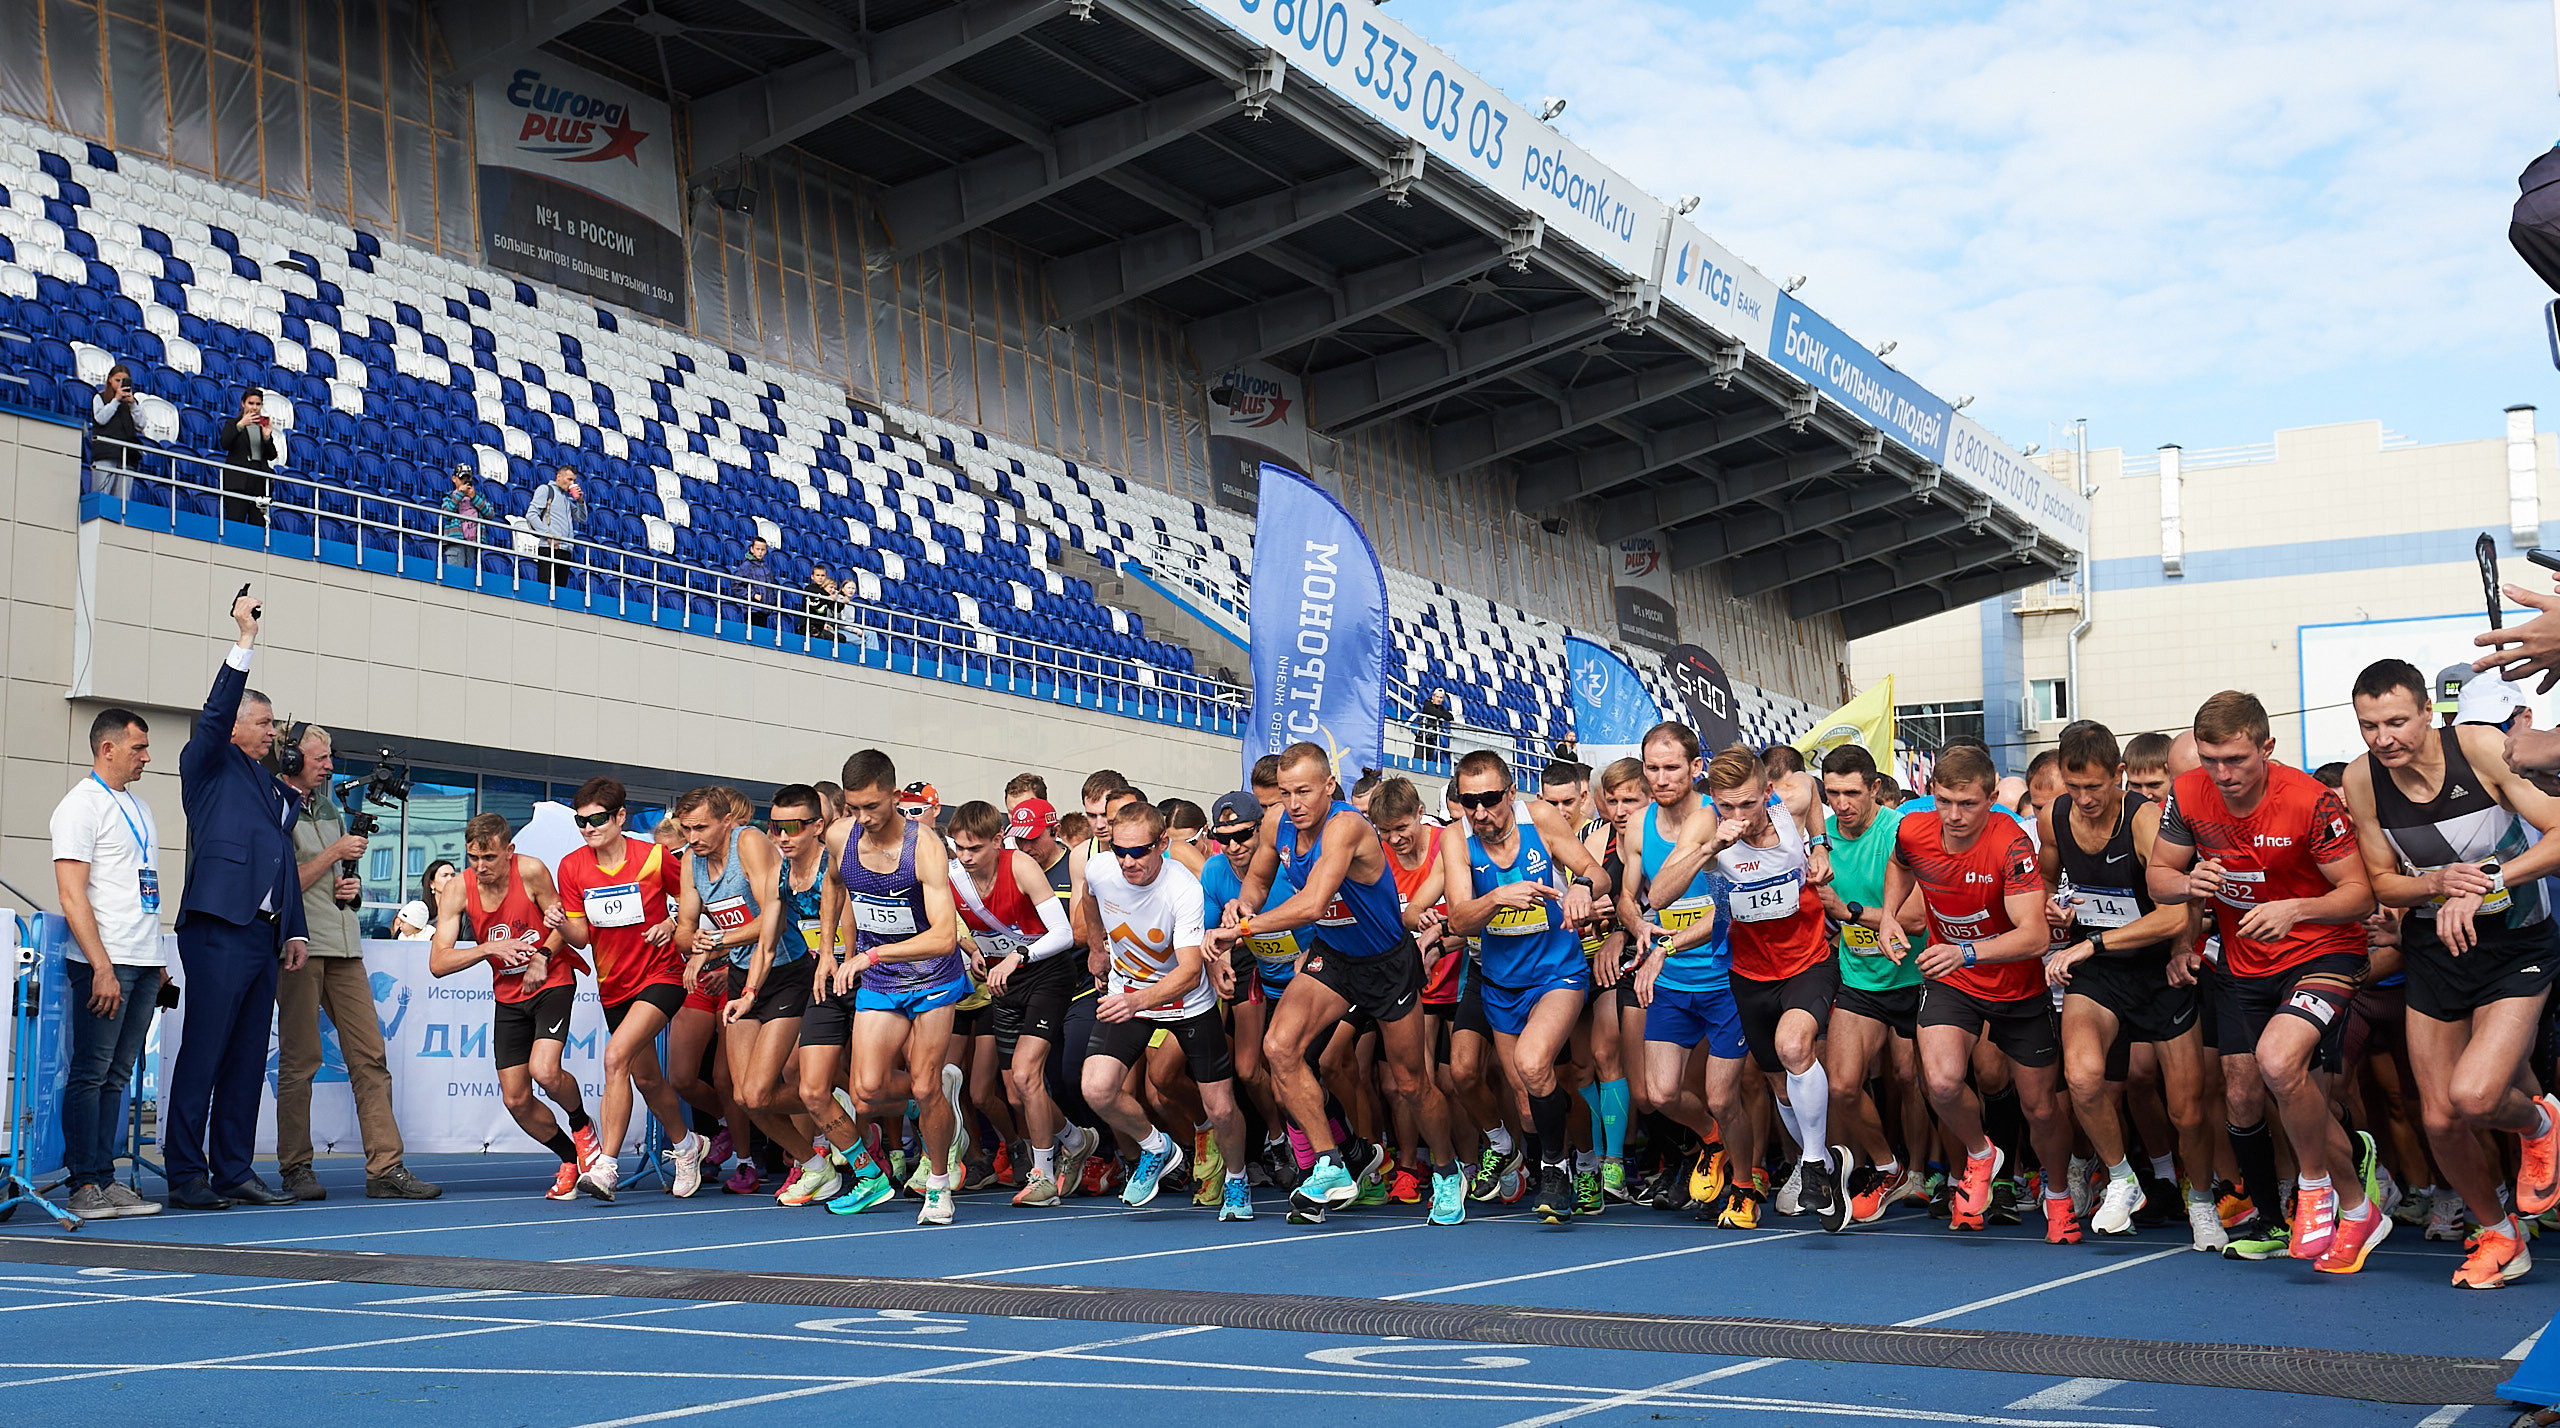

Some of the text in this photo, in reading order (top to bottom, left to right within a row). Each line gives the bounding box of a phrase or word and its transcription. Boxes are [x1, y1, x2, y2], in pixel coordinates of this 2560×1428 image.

[1354, 20, 1418, 112] 333
[1423, 70, 1464, 142] 03
[1469, 100, 1508, 170] 03
[1522, 143, 1635, 243] psbank.ru
[536, 205, 562, 231] №1
[580, 219, 634, 256] РОССИИ
[494, 234, 674, 304] БОЛЬШЕ ХИТОВ! БОЛЬШЕ МУЗЫКИ! 103.0
[1699, 258, 1761, 322] ПСБ БАНК
[1785, 312, 1941, 450] Банк сильных людей
[1955, 429, 2085, 533] 8 800 333 03 03 psbank.ru
[1676, 662, 1727, 720] 5:00
[2267, 837, 2292, 847] ПСБ
[604, 899, 622, 915] 69
[1747, 890, 1784, 910] 184
[715, 909, 745, 927] 1120
[868, 908, 897, 923] 155
[1939, 921, 1985, 937] 1051
[1254, 941, 1285, 954] 532
[428, 986, 494, 1003] История
